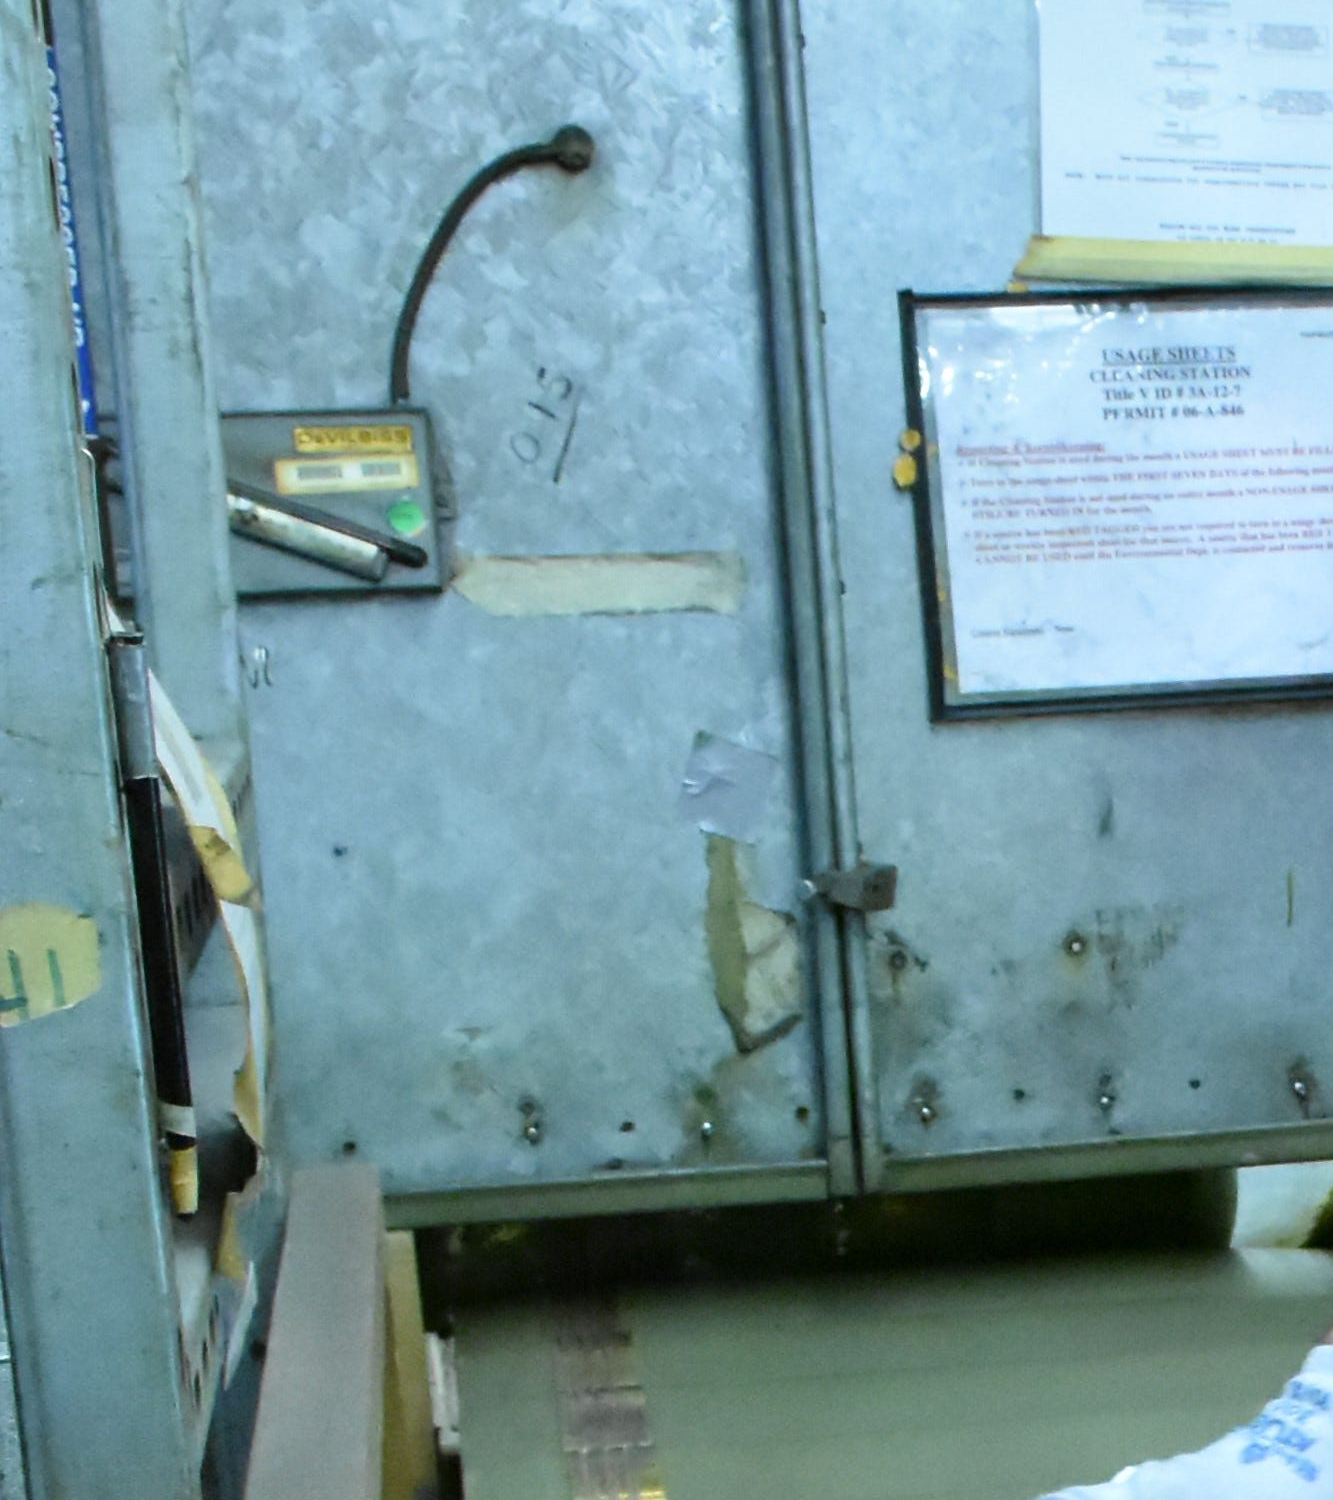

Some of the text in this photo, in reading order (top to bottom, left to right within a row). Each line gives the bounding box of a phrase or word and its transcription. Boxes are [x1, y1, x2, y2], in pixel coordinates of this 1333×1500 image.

[1102, 346, 1236, 365] USAGE SHEETS
[1180, 366, 1251, 381] STATION
[1104, 387, 1134, 401] Title
[1155, 386, 1171, 400] ID
[1102, 406, 1165, 421] PERMIT
